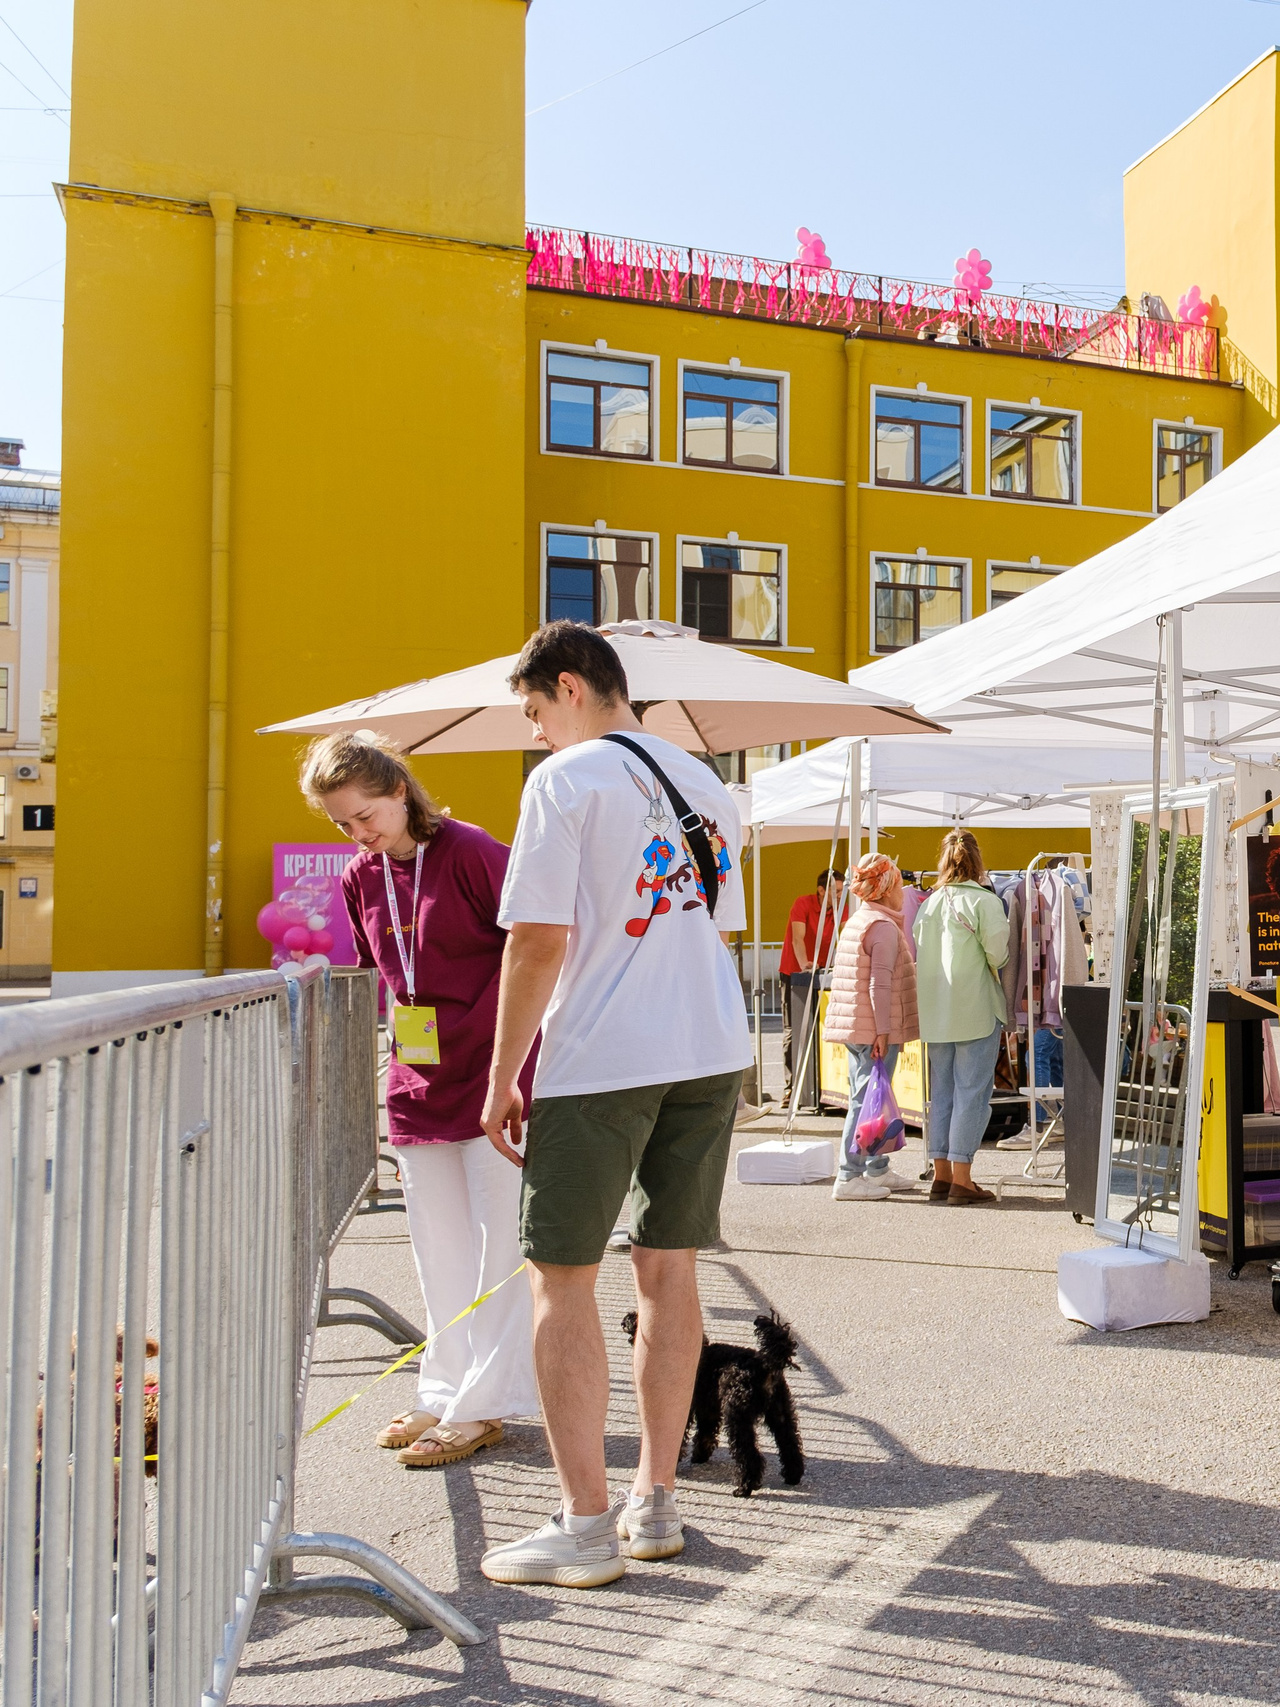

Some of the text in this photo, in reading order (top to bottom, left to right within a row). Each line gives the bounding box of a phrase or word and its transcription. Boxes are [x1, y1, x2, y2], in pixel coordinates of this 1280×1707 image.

[33, 808, 42, 828] 1
[1257, 911, 1280, 923] The
[1258, 926, 1267, 937] is
[1269, 925, 1280, 937] in
